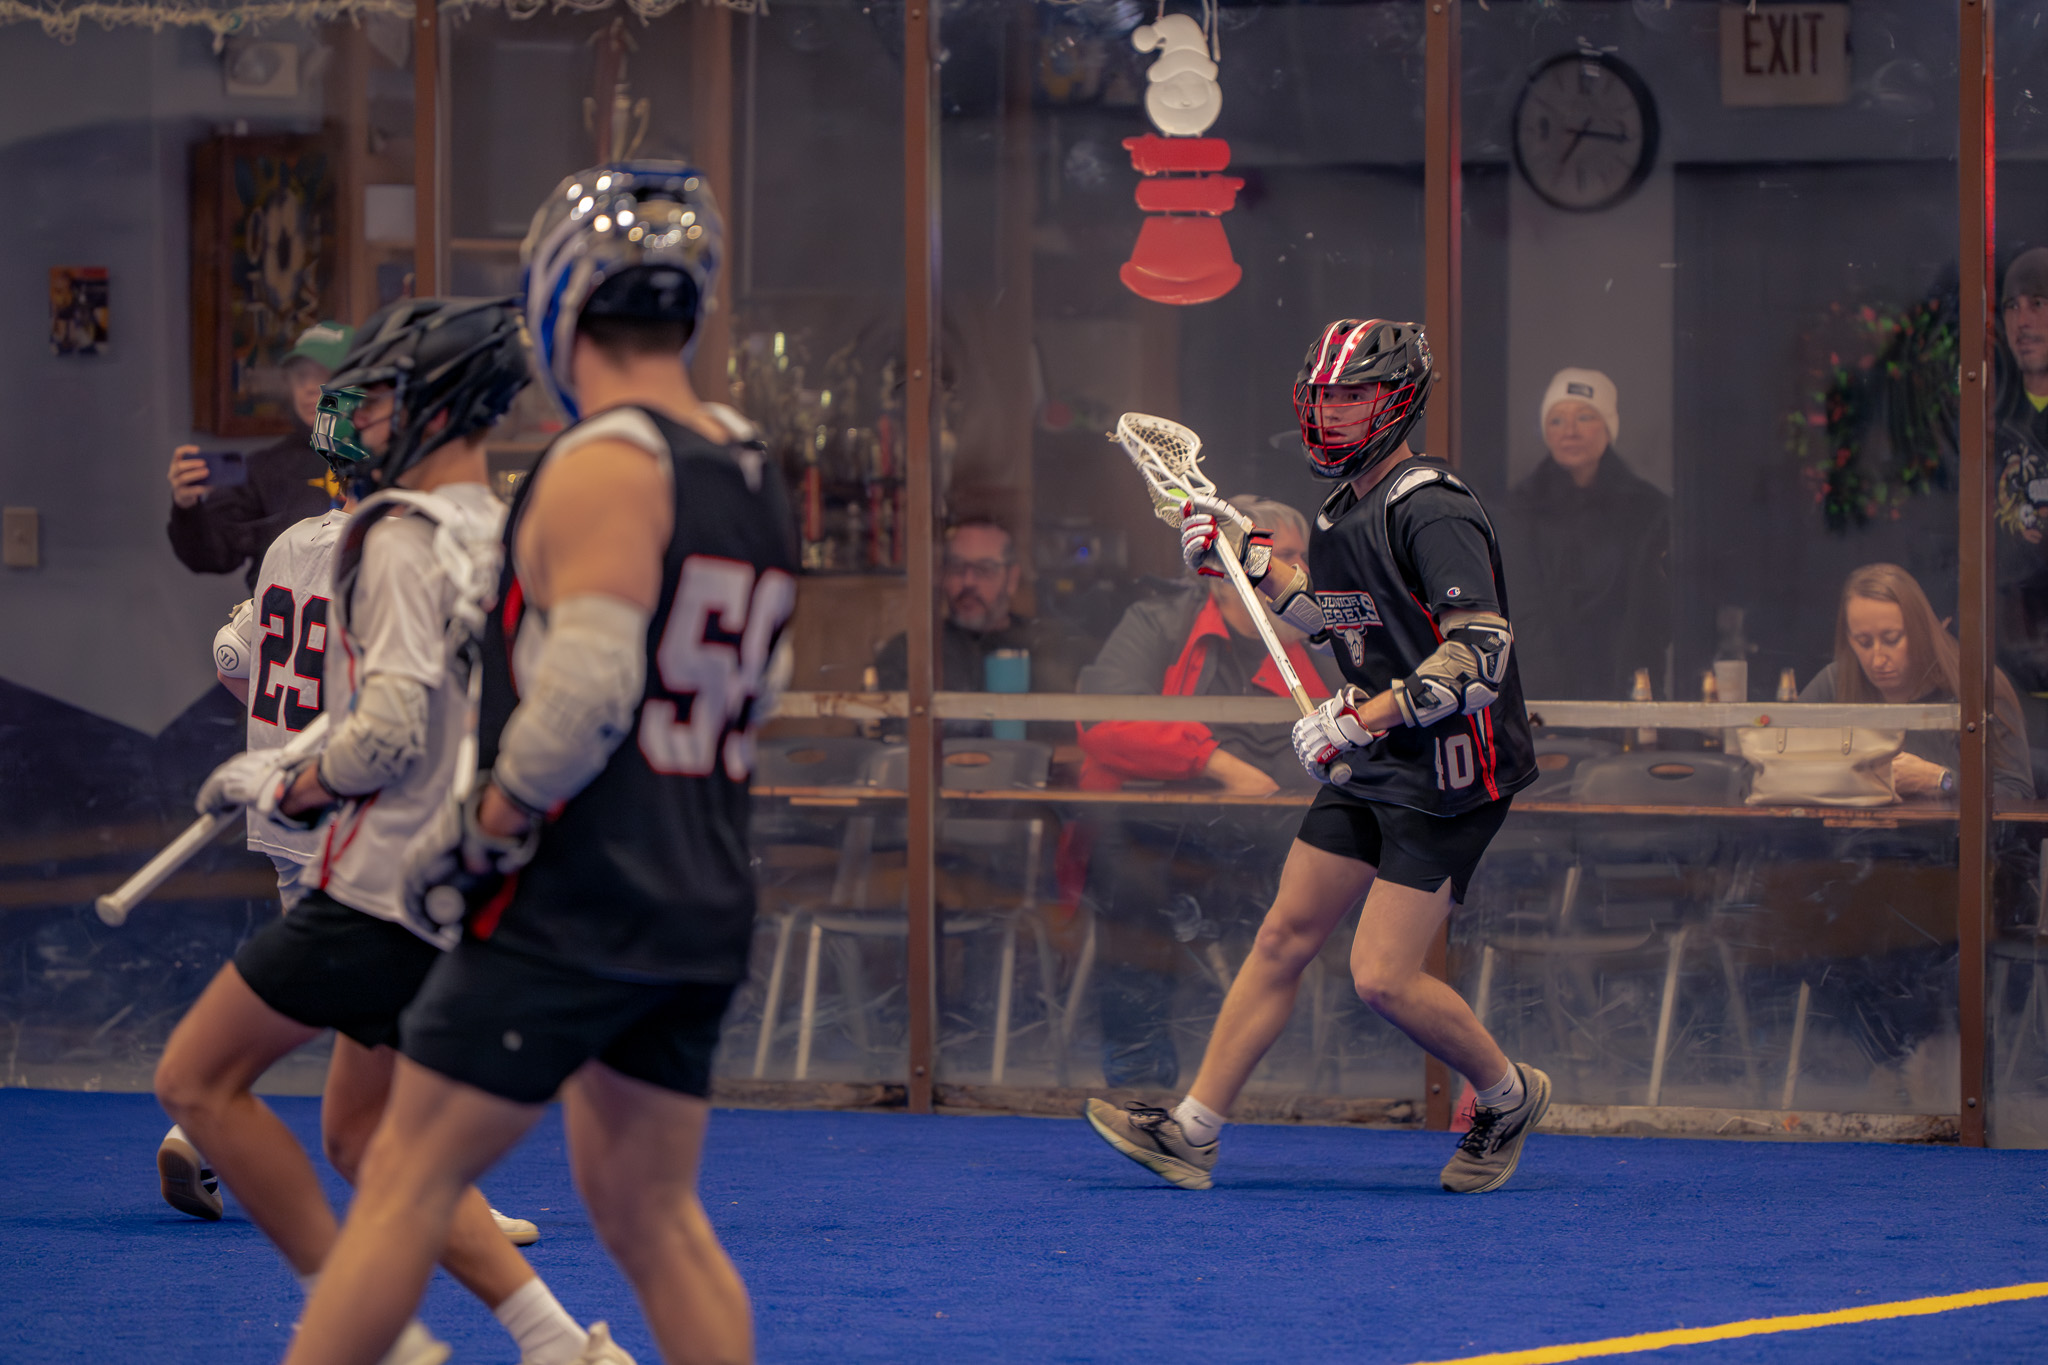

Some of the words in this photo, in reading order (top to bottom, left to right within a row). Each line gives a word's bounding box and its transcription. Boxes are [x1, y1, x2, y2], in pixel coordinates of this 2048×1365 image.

[1743, 12, 1825, 75] EXIT
[1321, 596, 1361, 608] JUNIOR
[251, 583, 331, 733] 29
[1321, 746, 1337, 761] STX
